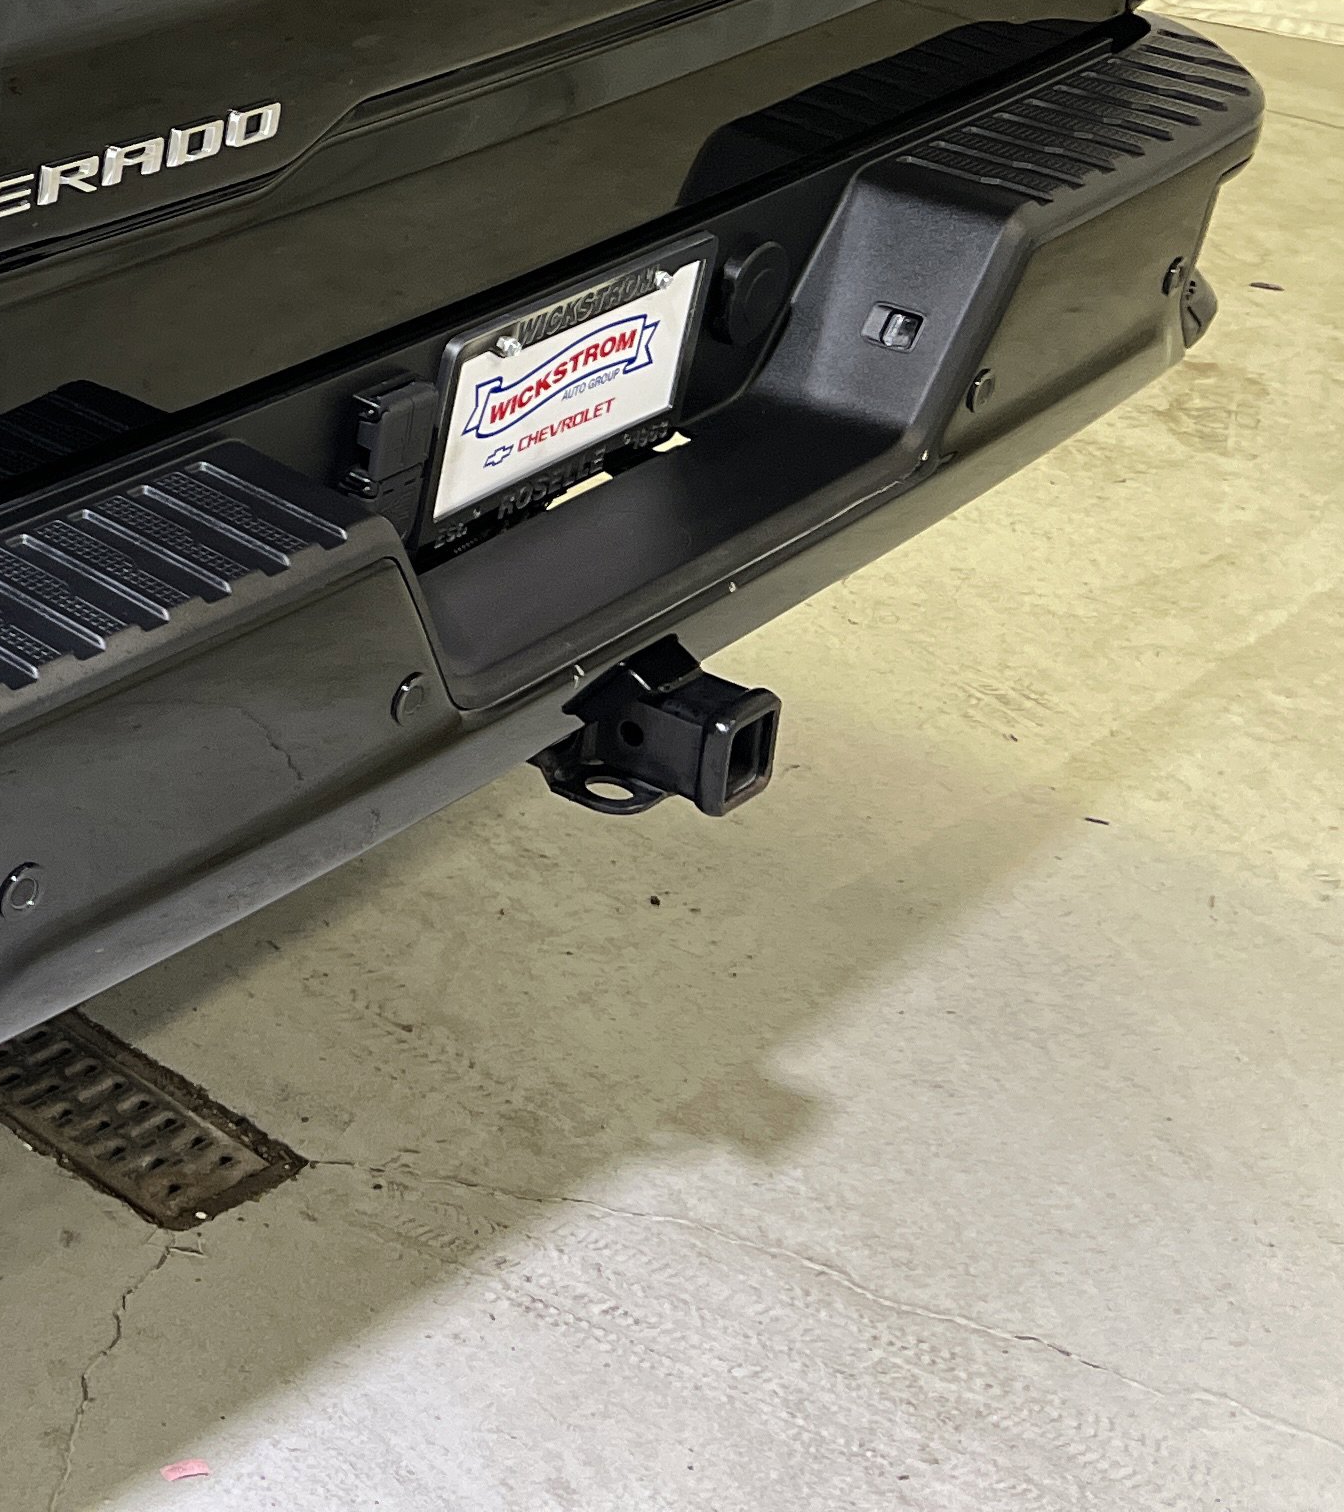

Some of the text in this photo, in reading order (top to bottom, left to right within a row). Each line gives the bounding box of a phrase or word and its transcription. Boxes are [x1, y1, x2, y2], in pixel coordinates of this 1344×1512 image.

[488, 328, 638, 425] WICKSTROM
[561, 368, 621, 402] AUTO GROUP
[516, 397, 617, 453] CHEVROLET
